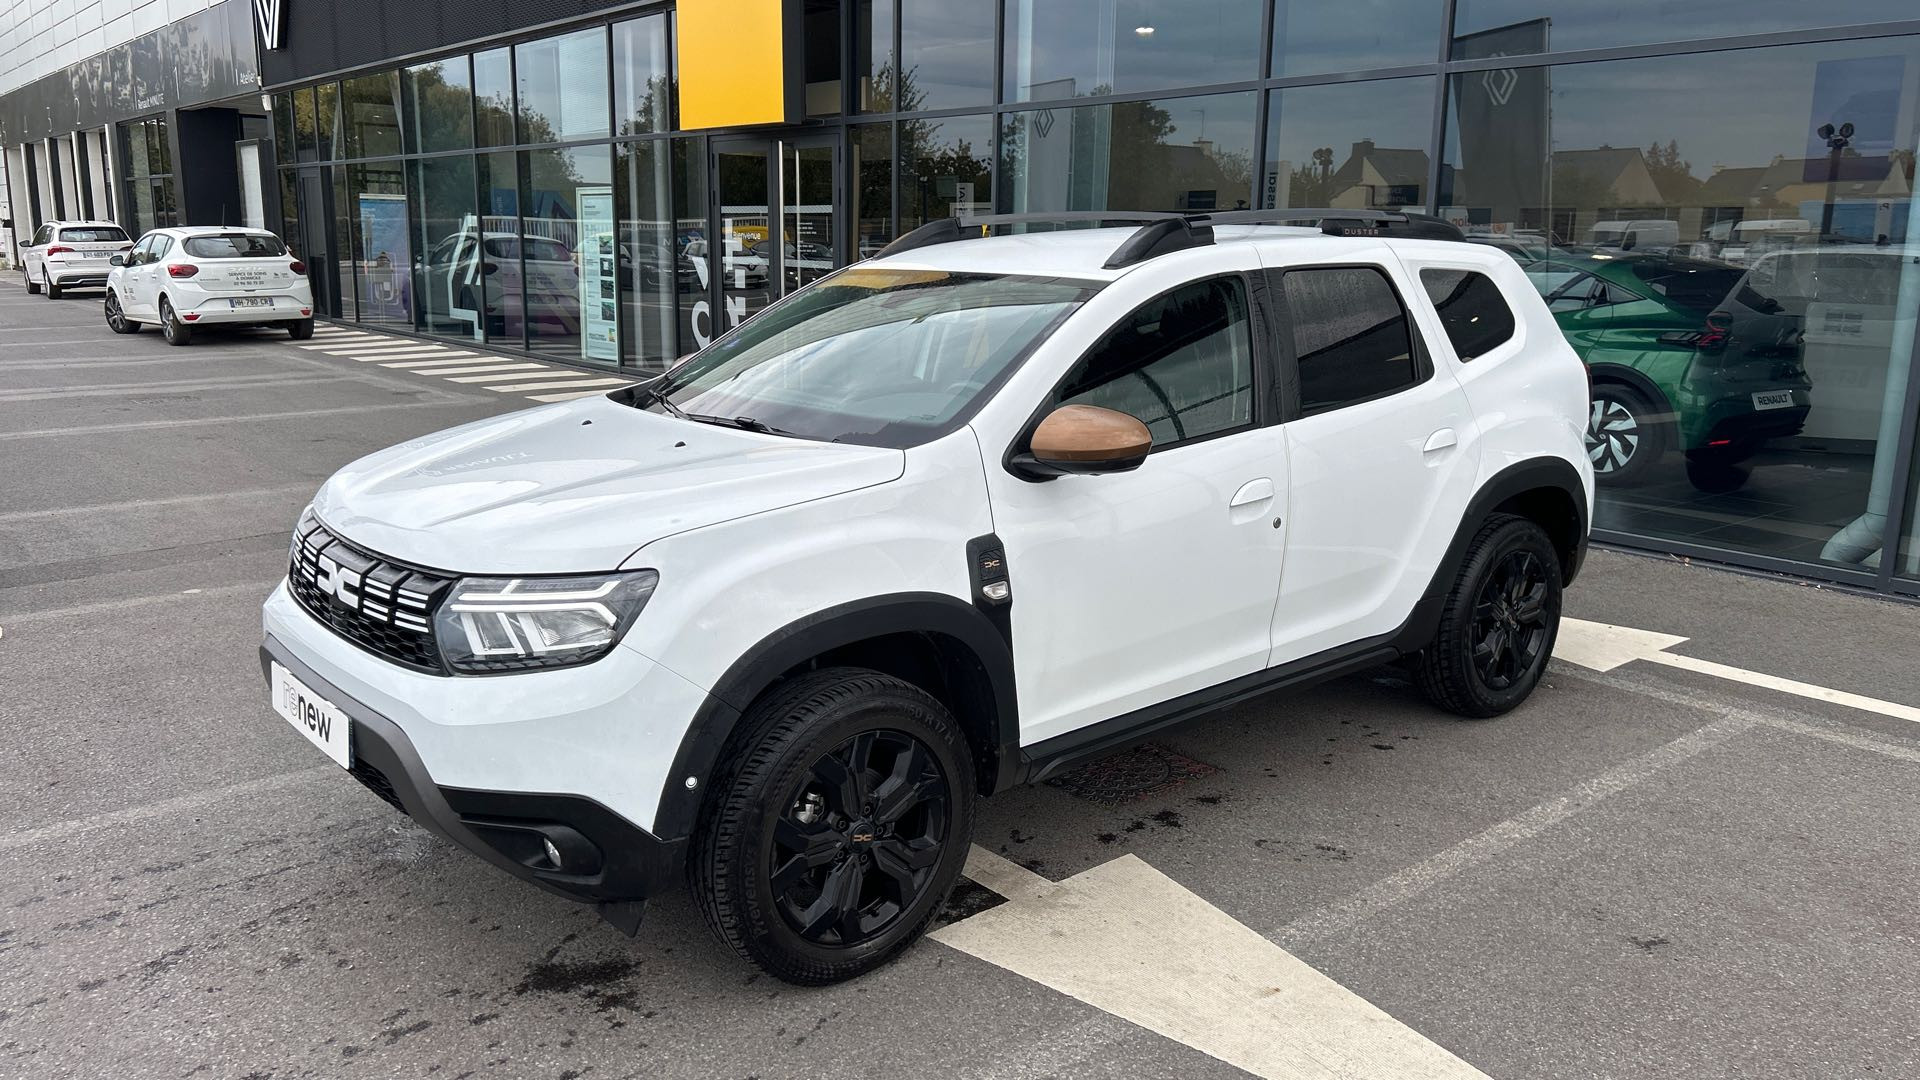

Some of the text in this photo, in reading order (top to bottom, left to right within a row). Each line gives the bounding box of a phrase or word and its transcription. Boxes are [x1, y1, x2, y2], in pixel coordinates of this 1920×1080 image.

[732, 231, 761, 240] Bienvenue
[1758, 394, 1788, 405] RENAULT
[283, 681, 331, 742] renew
